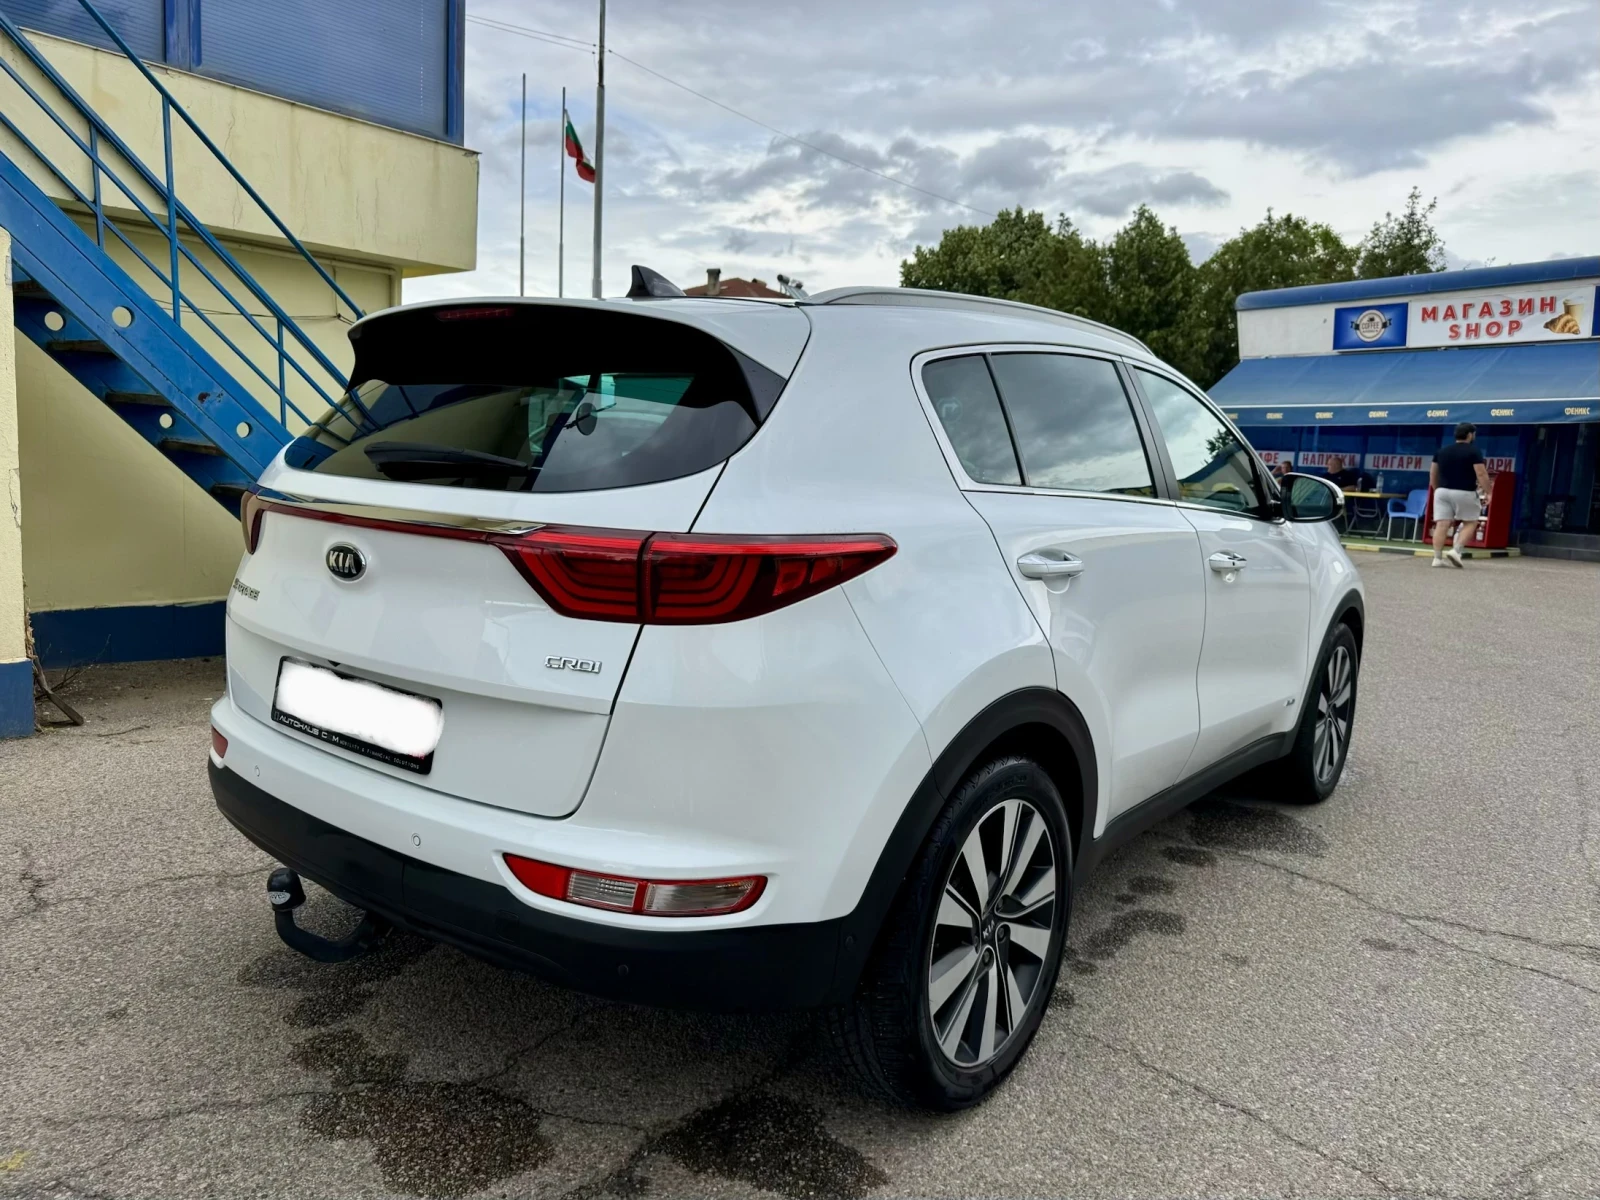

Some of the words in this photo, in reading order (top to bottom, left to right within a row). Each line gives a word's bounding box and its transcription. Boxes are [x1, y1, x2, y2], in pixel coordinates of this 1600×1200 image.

[1421, 296, 1557, 322] МАГАЗИН
[1361, 321, 1380, 330] COFFEE
[1449, 320, 1522, 340] SHOP
[1490, 408, 1514, 417] ФЕНИКС
[1564, 407, 1591, 416] ФЕНИКС
[1302, 453, 1356, 467] НАПИКИ
[1373, 455, 1422, 470] ЦИГАРИ
[329, 550, 357, 574] KIA
[544, 655, 602, 674] CRDI
[279, 715, 320, 736] AUTOHAUS
